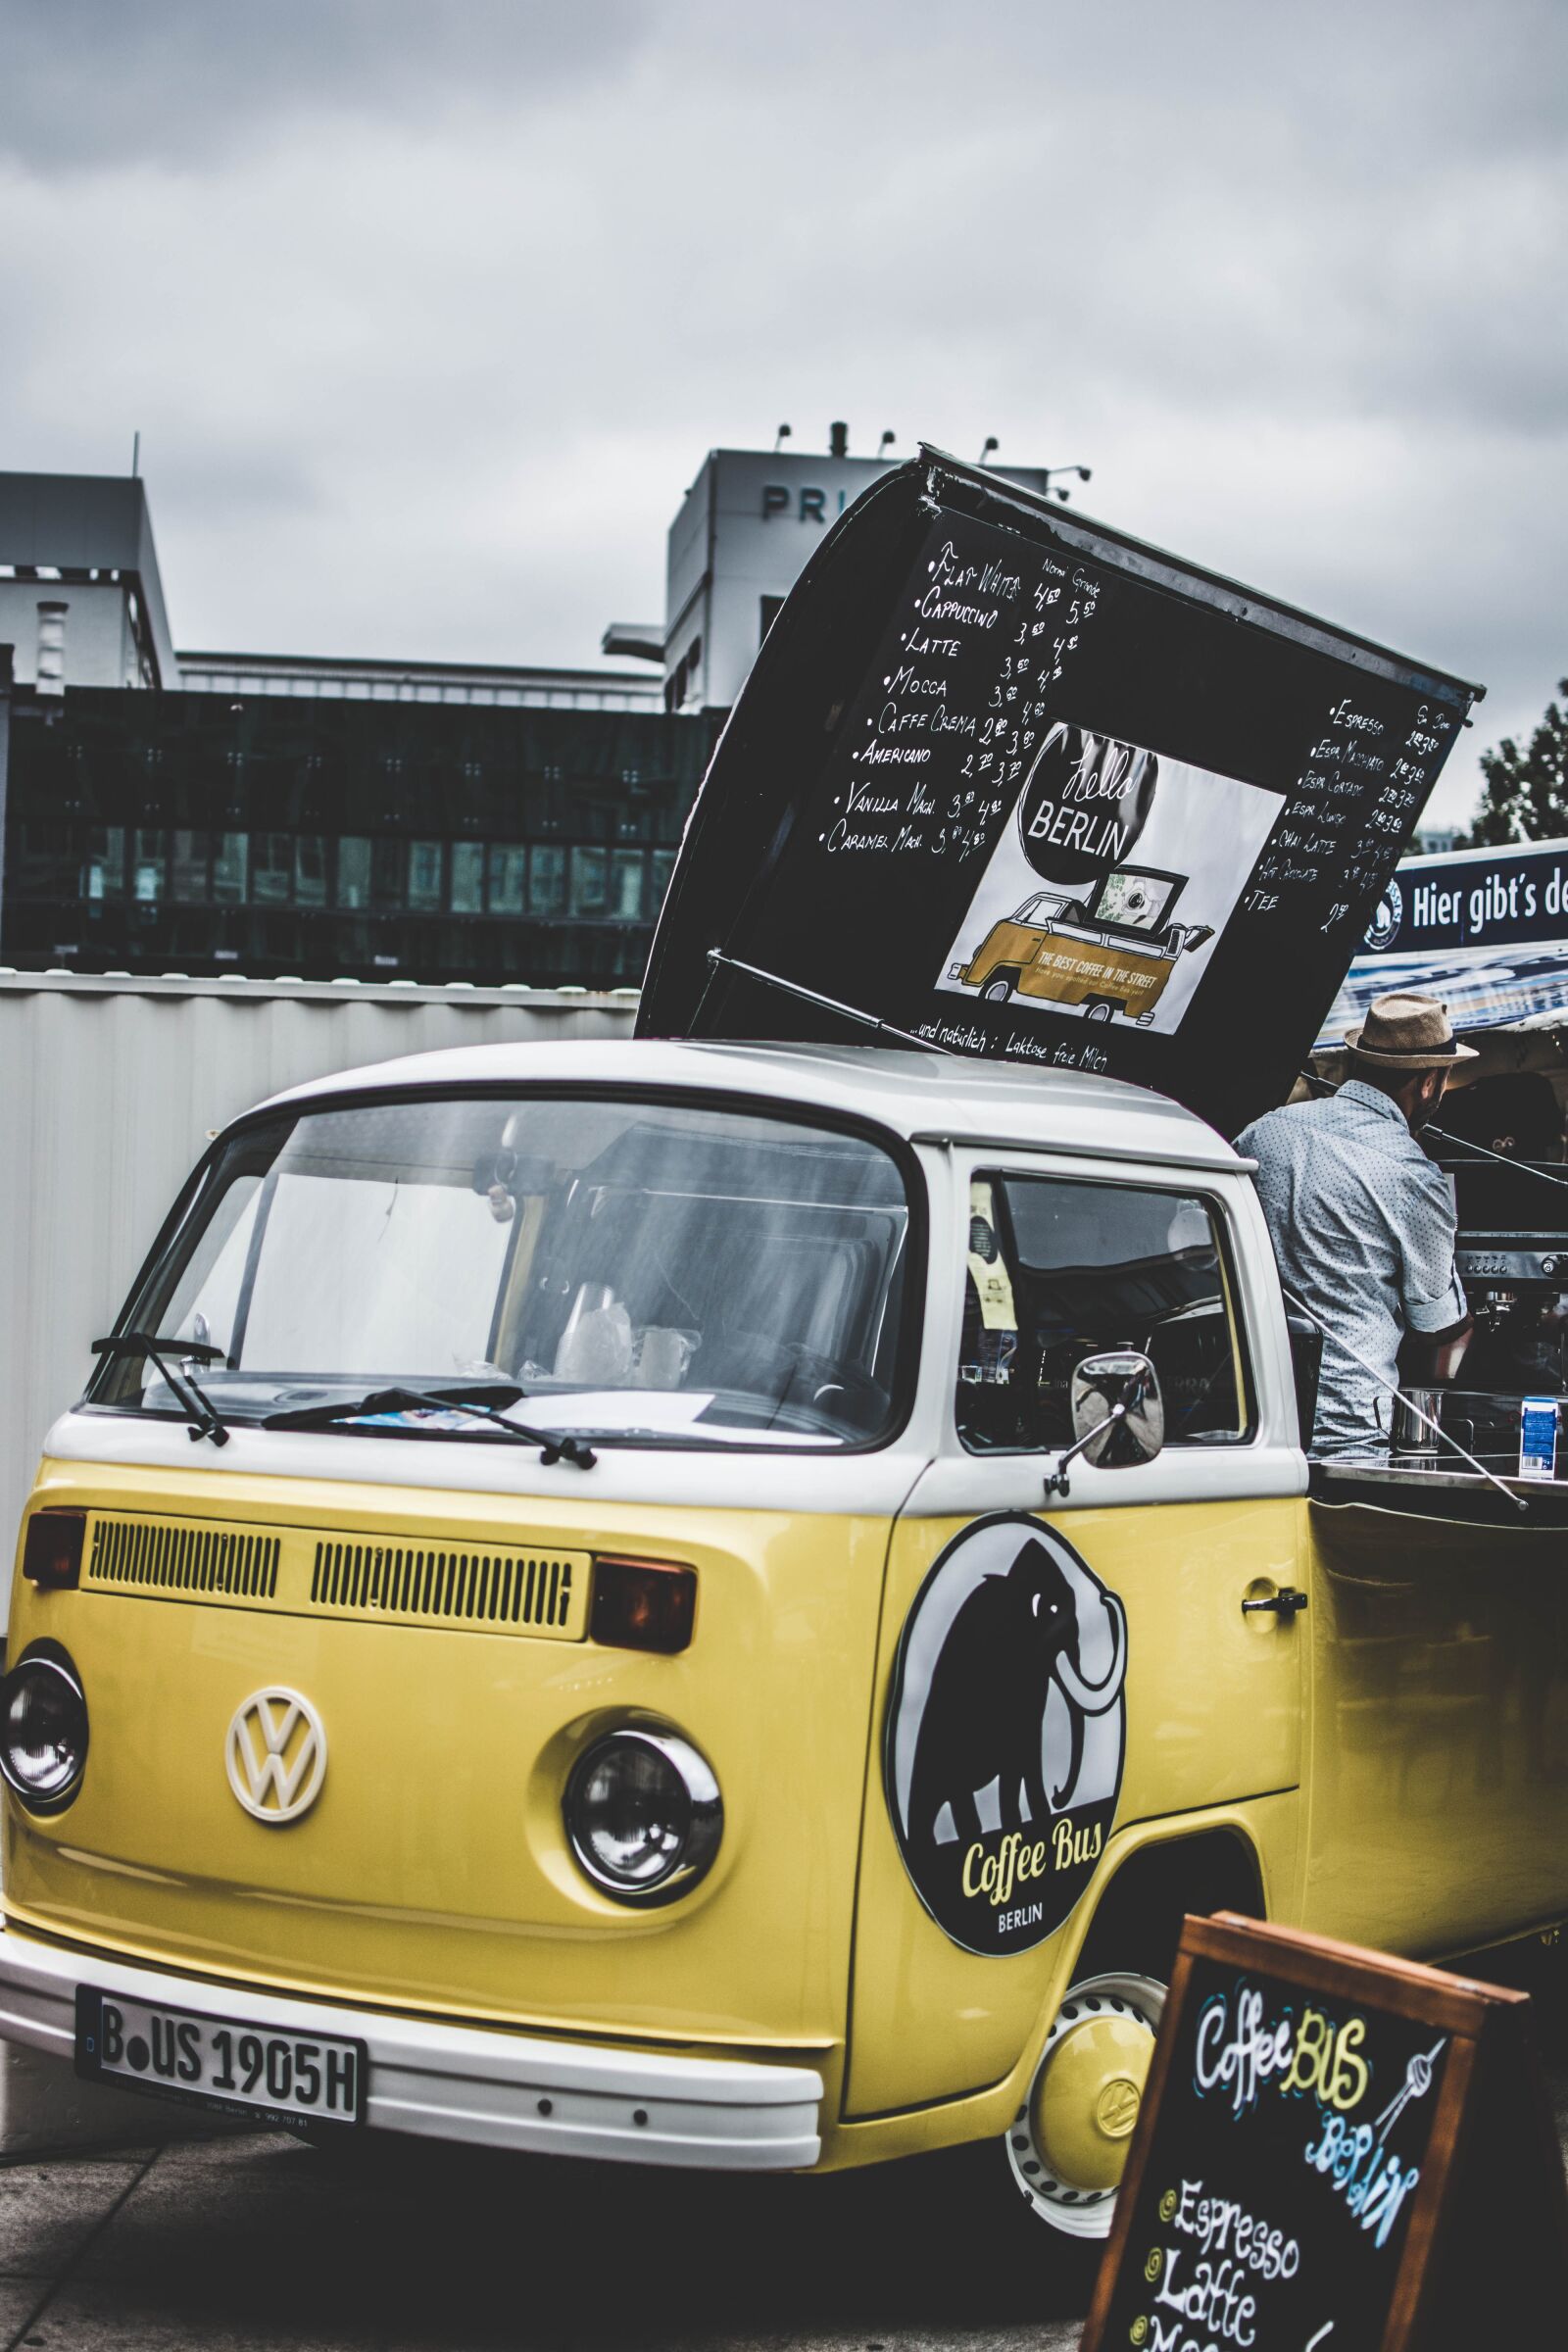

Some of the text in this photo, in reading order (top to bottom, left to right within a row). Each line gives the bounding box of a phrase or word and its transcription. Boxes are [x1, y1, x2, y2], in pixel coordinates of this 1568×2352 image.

[905, 627, 961, 657] LATTE
[888, 666, 947, 697] MOCCA
[931, 704, 976, 737] CREMA
[860, 739, 931, 764] AMERICANO
[846, 781, 899, 813] VANILLA
[827, 818, 888, 852] CARAMEL
[1028, 800, 1129, 861] BERLIN
[1249, 890, 1279, 911] TEE
[1413, 882, 1462, 927] Hier
[1470, 872, 1537, 934] gibt's
[1039, 952, 1158, 989] THE BEST COFFEE IN THE STREET
[1005, 1032, 1047, 1058] Laktose
[962, 1818, 1102, 1905] Coffee Bus
[998, 1902, 1043, 1934] BERLIN
[102, 2004, 355, 2112] B US 1905H
[1175, 2179, 1300, 2280] Espresso
[1153, 2247, 1256, 2347] Latte
